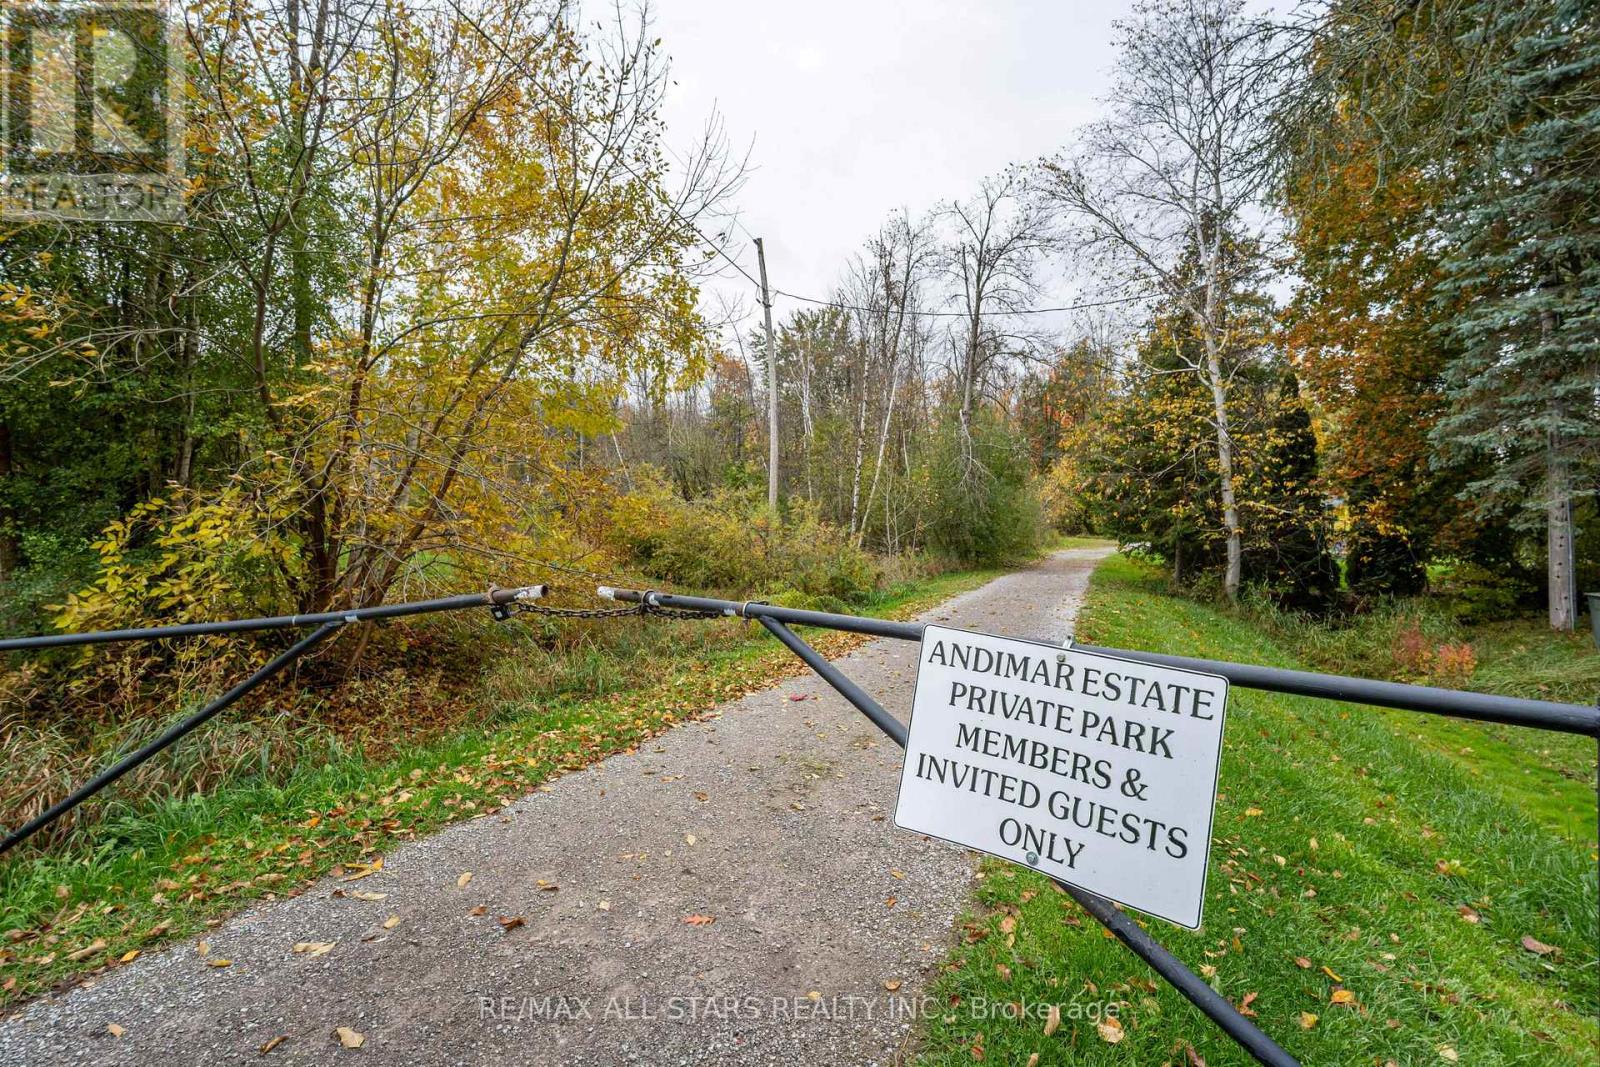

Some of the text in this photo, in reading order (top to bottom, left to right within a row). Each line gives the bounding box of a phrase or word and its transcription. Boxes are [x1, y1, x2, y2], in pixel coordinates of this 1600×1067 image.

[927, 640, 1215, 721] ANDIMAR ESTATE
[948, 681, 1175, 760] PRIVATE PARK
[955, 722, 1149, 802] MEMBERS &
[916, 752, 1188, 859] INVITED GUESTS
[999, 817, 1086, 870] ONLY
